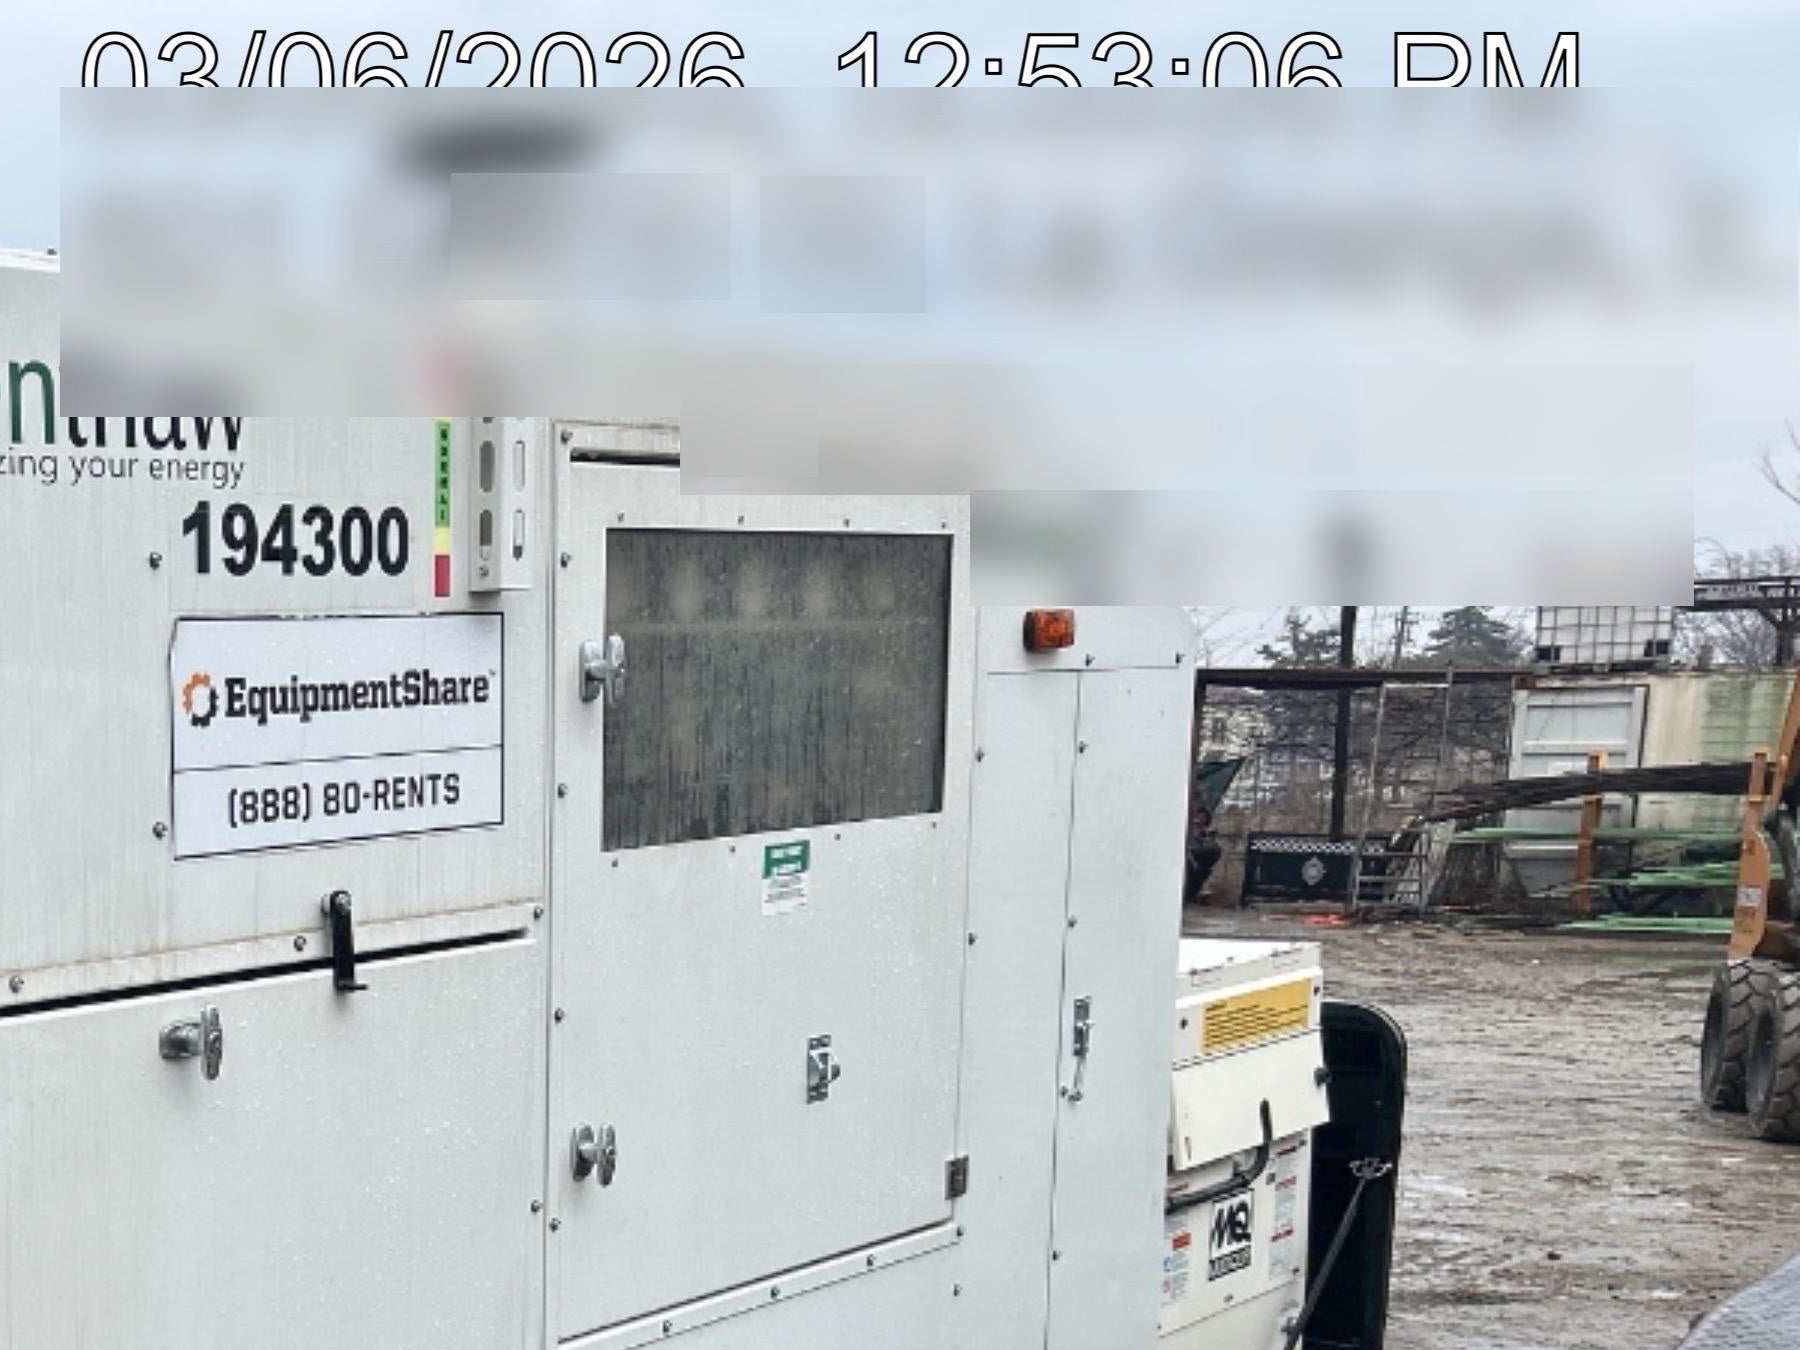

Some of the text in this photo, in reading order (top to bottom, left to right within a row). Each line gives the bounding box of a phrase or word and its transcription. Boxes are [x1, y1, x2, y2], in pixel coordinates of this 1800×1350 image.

[68, 452, 140, 488] your
[149, 456, 245, 489] energy
[181, 500, 410, 578] 194300
[224, 669, 490, 726] EquipmentShare
[228, 773, 461, 829] (888) 80-RENTS
